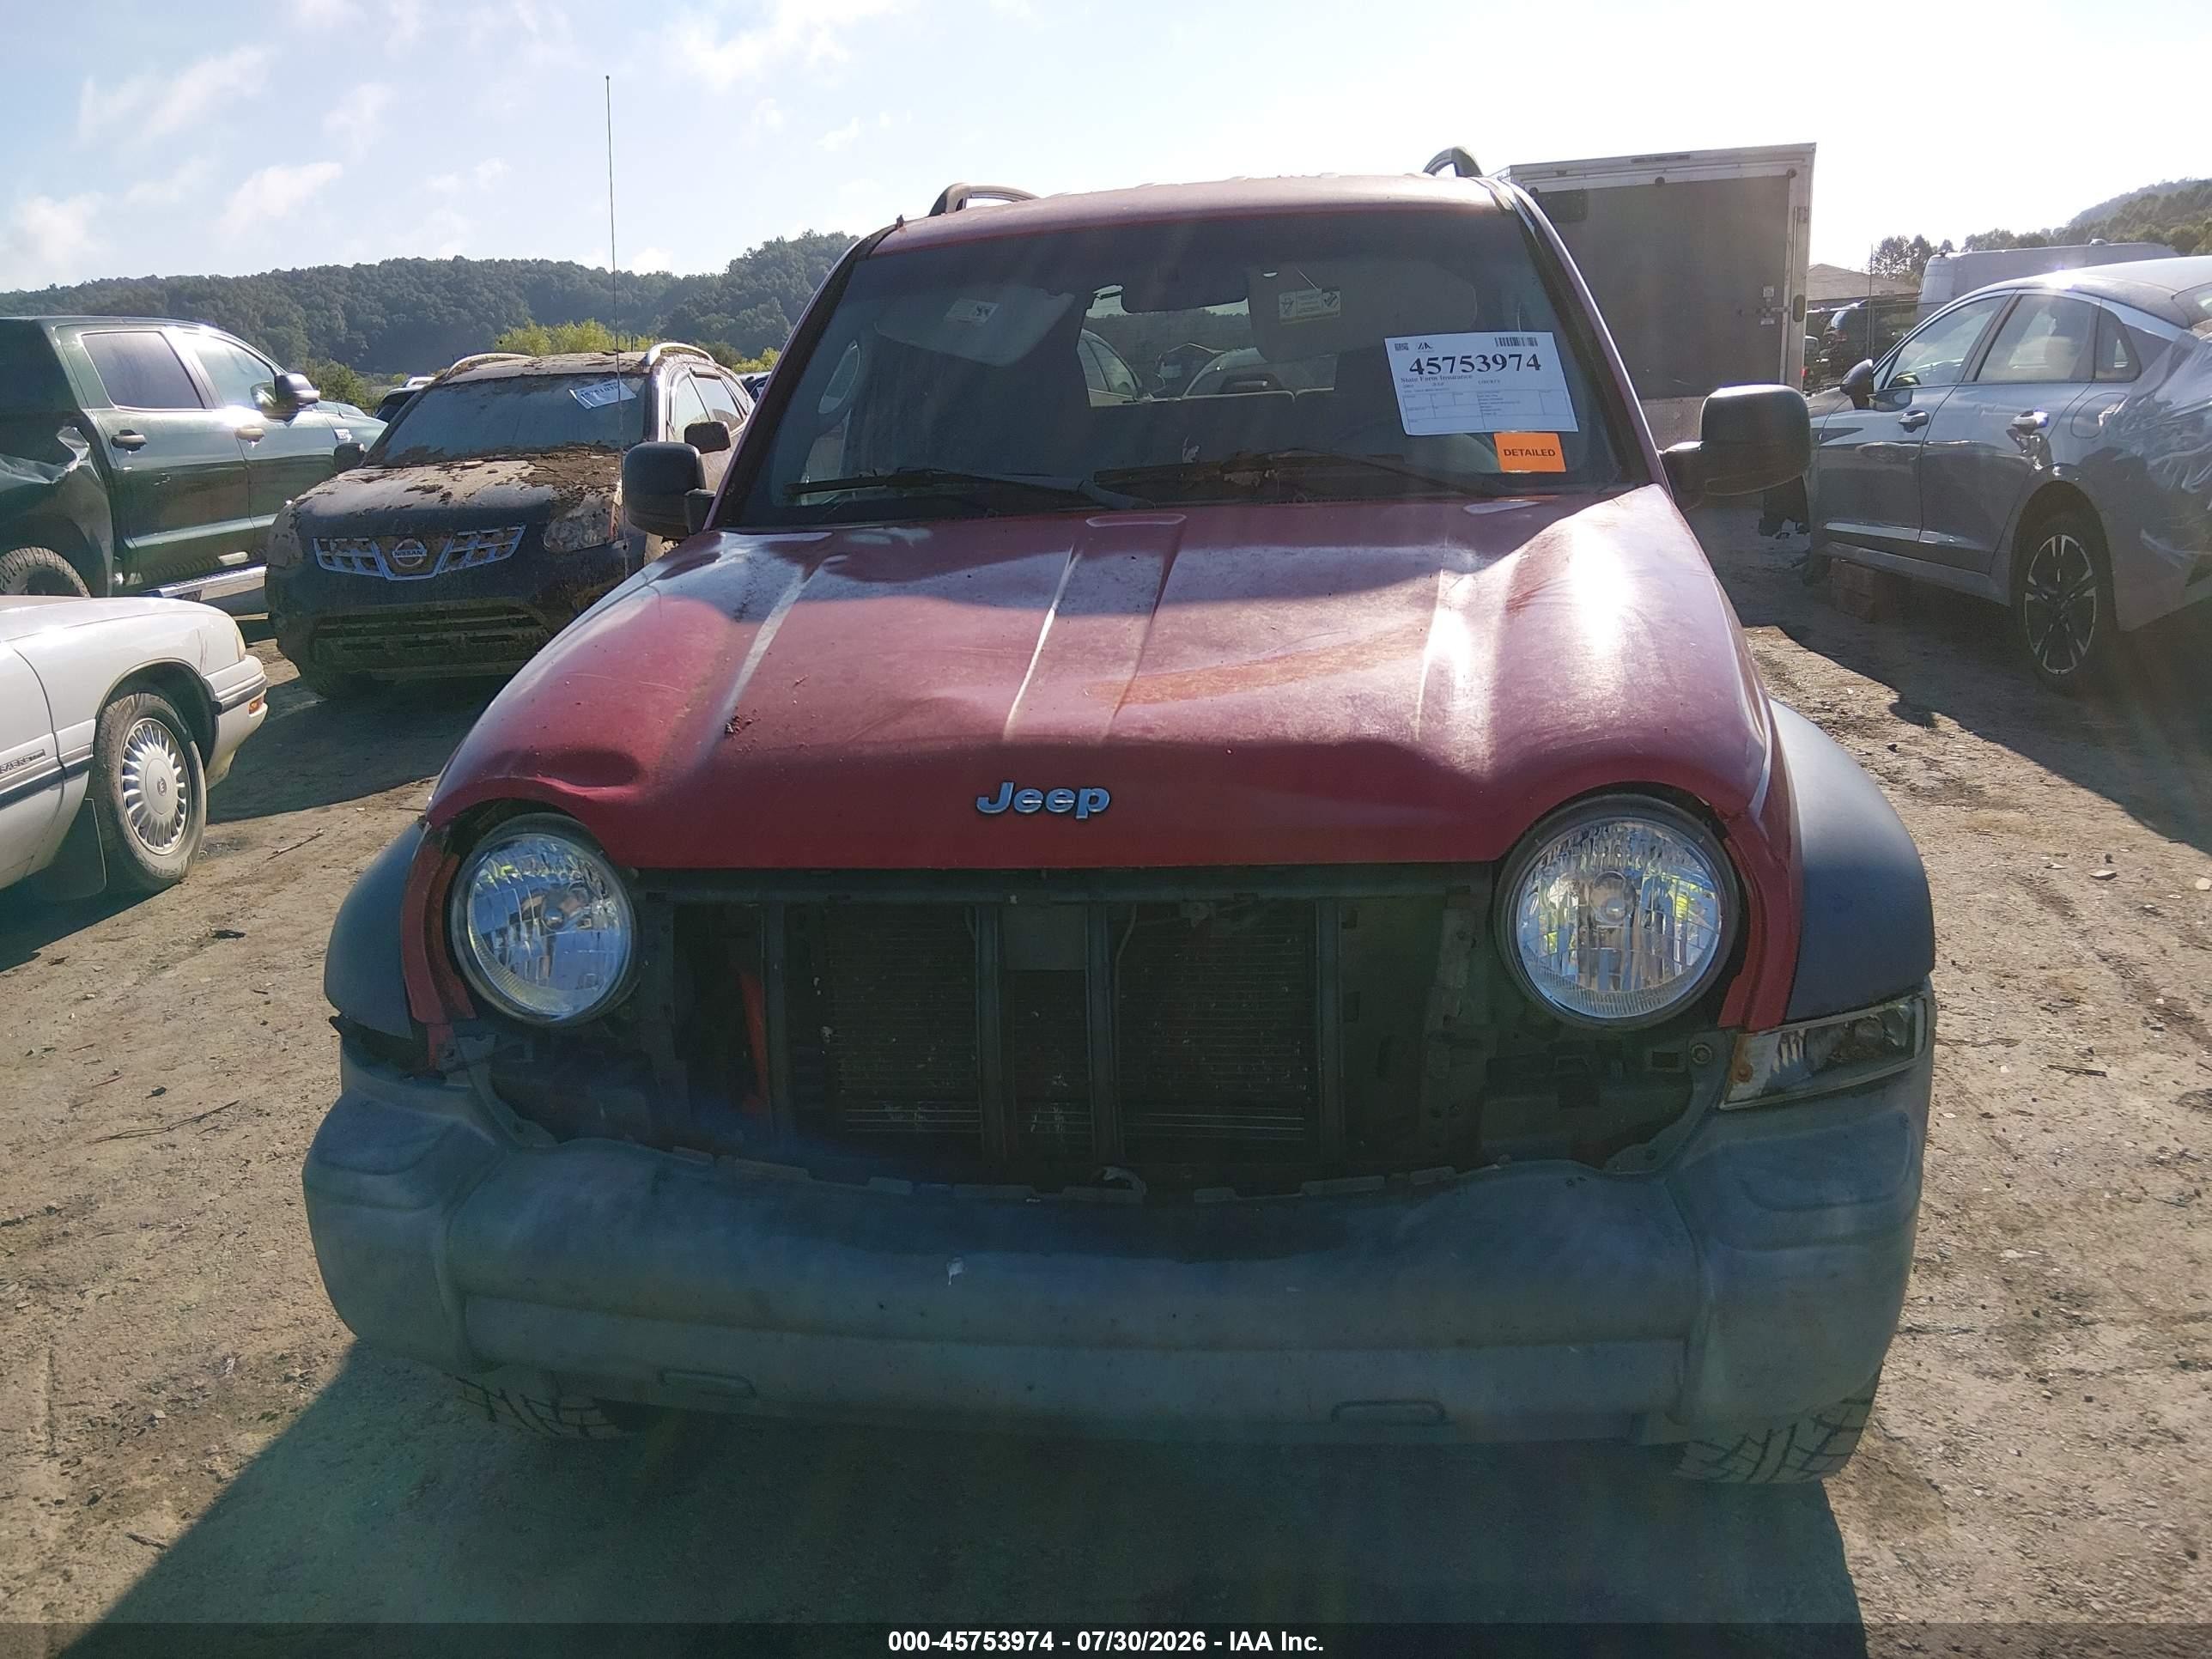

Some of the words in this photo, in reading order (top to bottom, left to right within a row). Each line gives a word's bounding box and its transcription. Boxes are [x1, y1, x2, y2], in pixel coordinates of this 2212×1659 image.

[1409, 353, 1541, 375] 45753974
[1503, 448, 1556, 457] DETAILED
[975, 781, 1110, 820] Jeep
